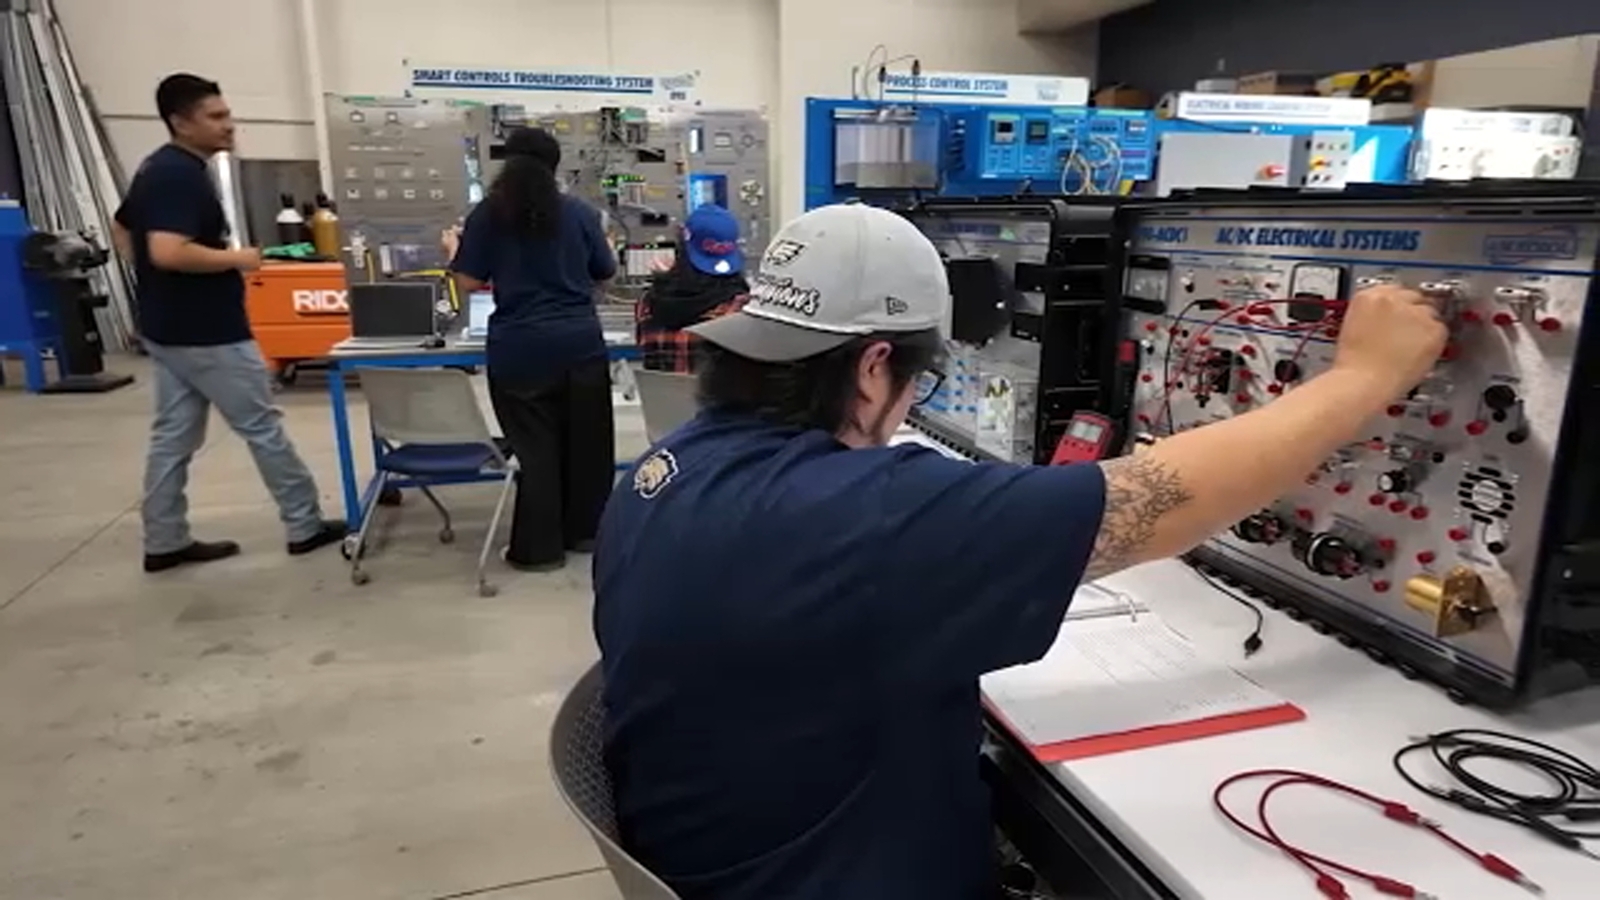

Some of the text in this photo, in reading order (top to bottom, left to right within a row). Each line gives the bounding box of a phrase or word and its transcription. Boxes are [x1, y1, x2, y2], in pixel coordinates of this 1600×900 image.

[413, 69, 452, 81] SMART
[454, 70, 511, 83] CONTROLS
[514, 72, 613, 87] TROUBLESHOOTING
[615, 76, 653, 88] SYSTEM
[886, 74, 1008, 90] PROCESS CONTROL SYSTEM
[1215, 226, 1421, 250] AC/DC ELECTRICAL SYSTEMS
